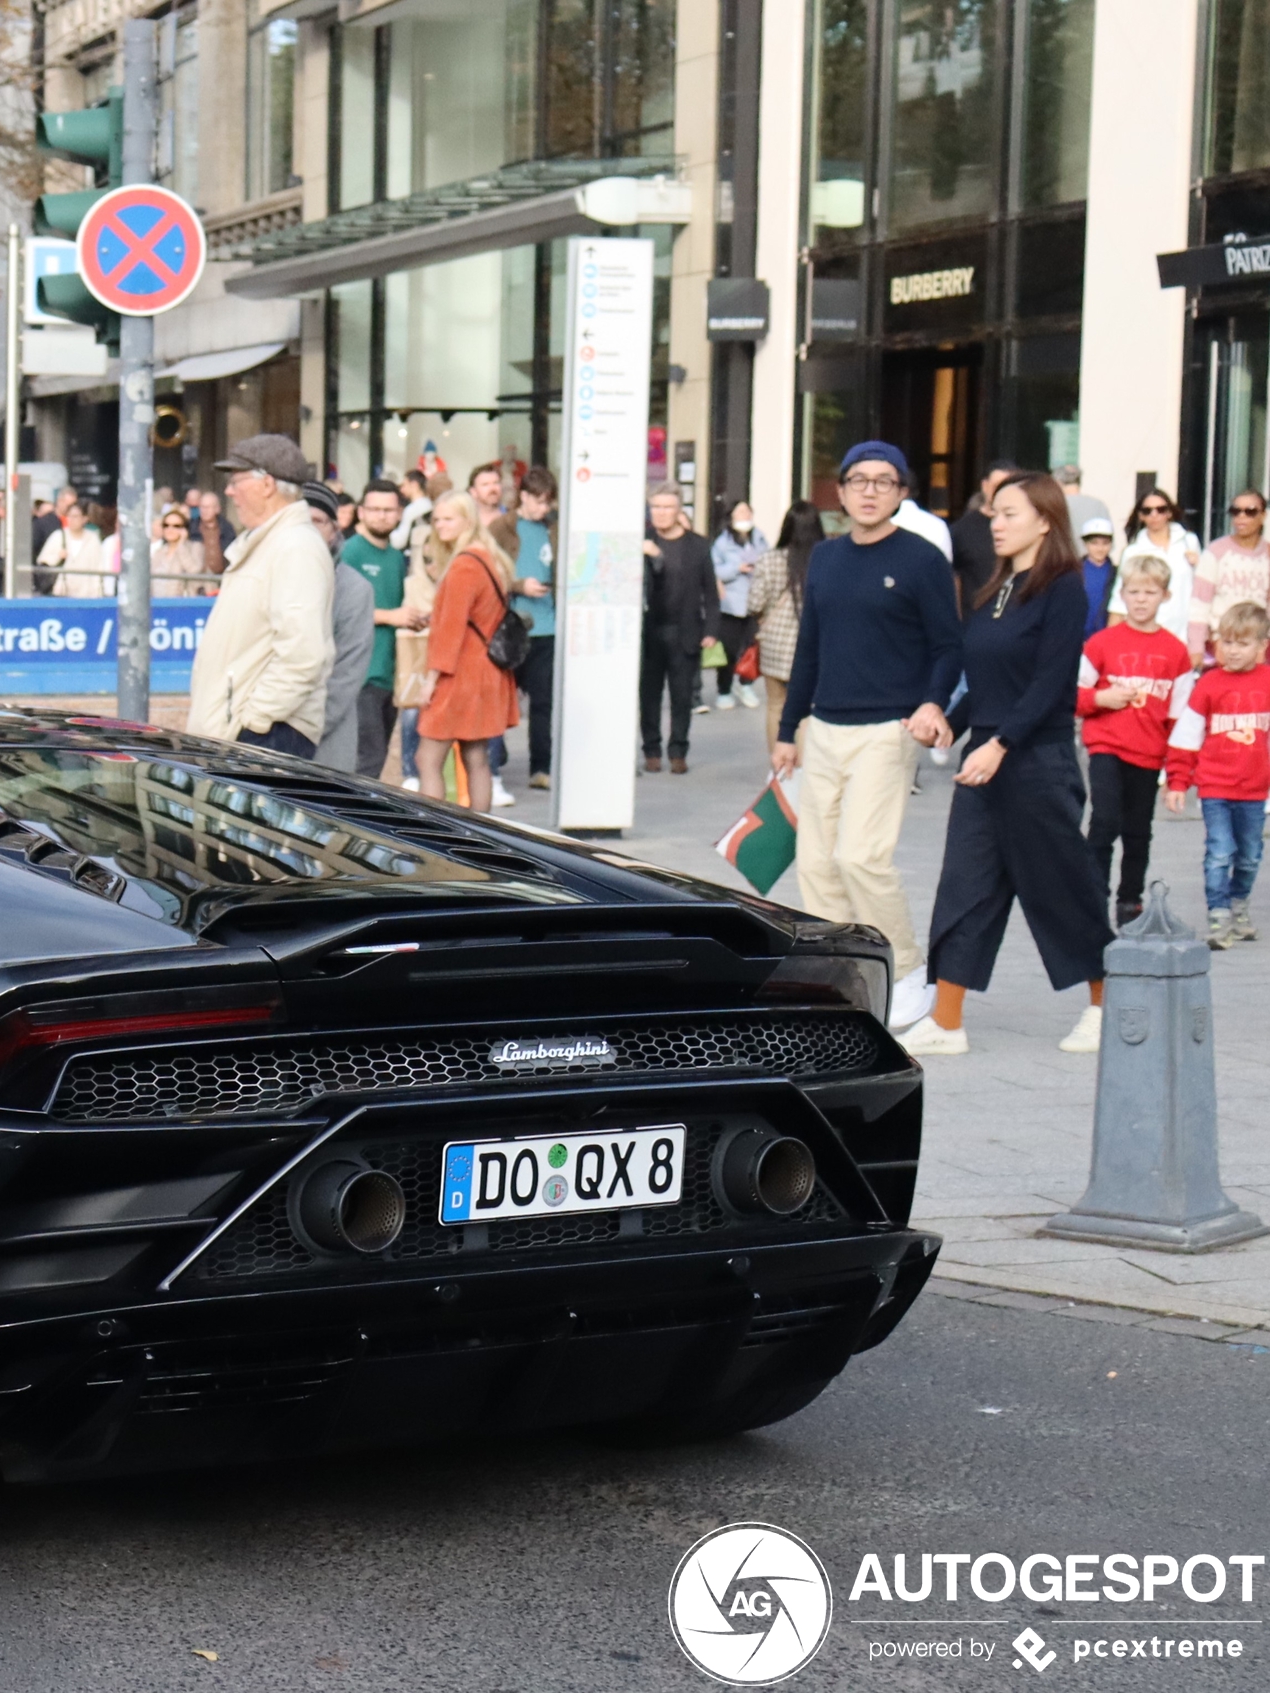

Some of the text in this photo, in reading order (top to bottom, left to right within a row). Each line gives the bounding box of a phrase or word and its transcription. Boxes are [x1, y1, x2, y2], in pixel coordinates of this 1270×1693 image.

[891, 266, 974, 304] BURBERRY
[96, 619, 113, 654] /
[493, 1041, 610, 1062] Lamborghini
[475, 1138, 674, 1210] DO QX 8
[451, 1191, 463, 1208] D
